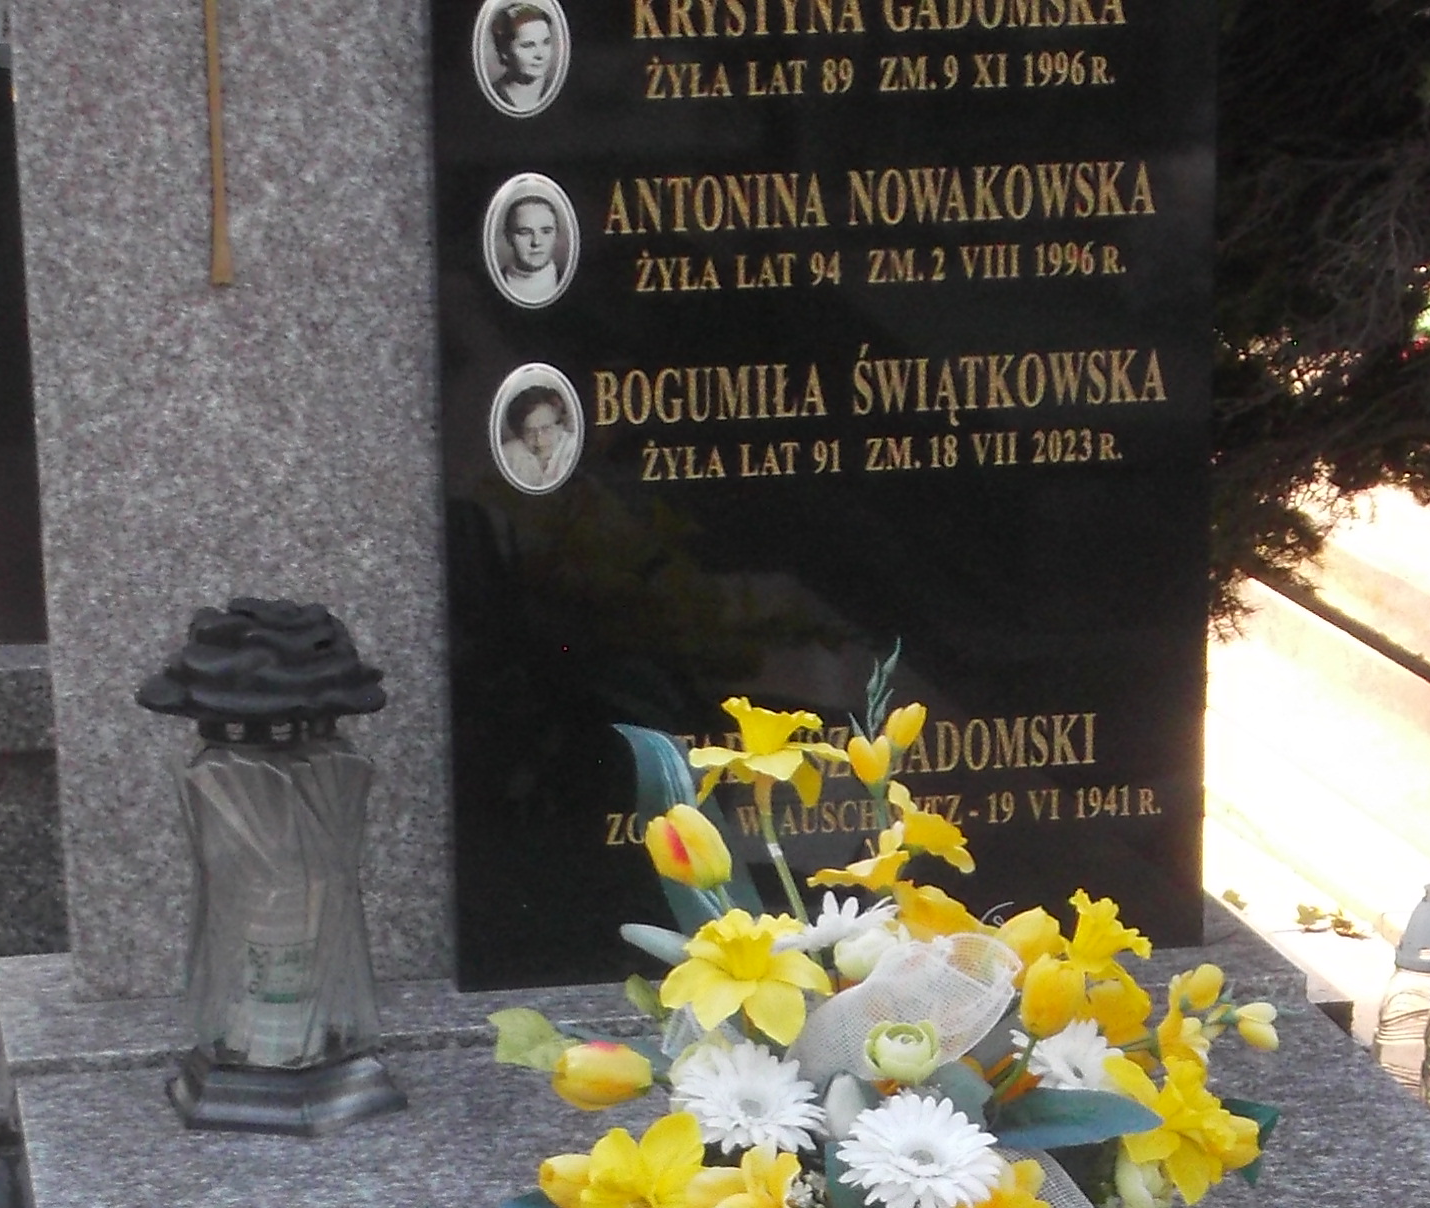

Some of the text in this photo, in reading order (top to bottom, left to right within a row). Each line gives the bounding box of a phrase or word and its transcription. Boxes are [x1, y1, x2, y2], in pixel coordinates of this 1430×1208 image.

[632, 0, 866, 39] KRYSTYNA
[645, 50, 1116, 99] ŻYŁA LAT 89 ZM. 9 XI 1996 R.
[604, 160, 1157, 235] ANTONINA NOWAKOWSKA
[635, 241, 1127, 293] ŻYŁA LAT 94 ZM. 2 VIII 1996 R.
[594, 342, 1168, 427] BOGUMIŁA ŚWIĄTKOWSKA
[642, 440, 726, 482] ŻYŁA
[740, 441, 801, 478] LAT
[813, 440, 842, 474] 91
[865, 436, 921, 472] ZM.
[971, 431, 1018, 467] VII
[1032, 428, 1093, 463] 2023
[1098, 432, 1124, 461] R.
[883, 712, 1098, 775] ADOMSKI
[781, 793, 964, 836] AUSCHTZ
[987, 790, 1015, 824] 19
[1027, 788, 1061, 822] VI
[1075, 783, 1131, 819] 1941
[1137, 787, 1163, 816] R.
